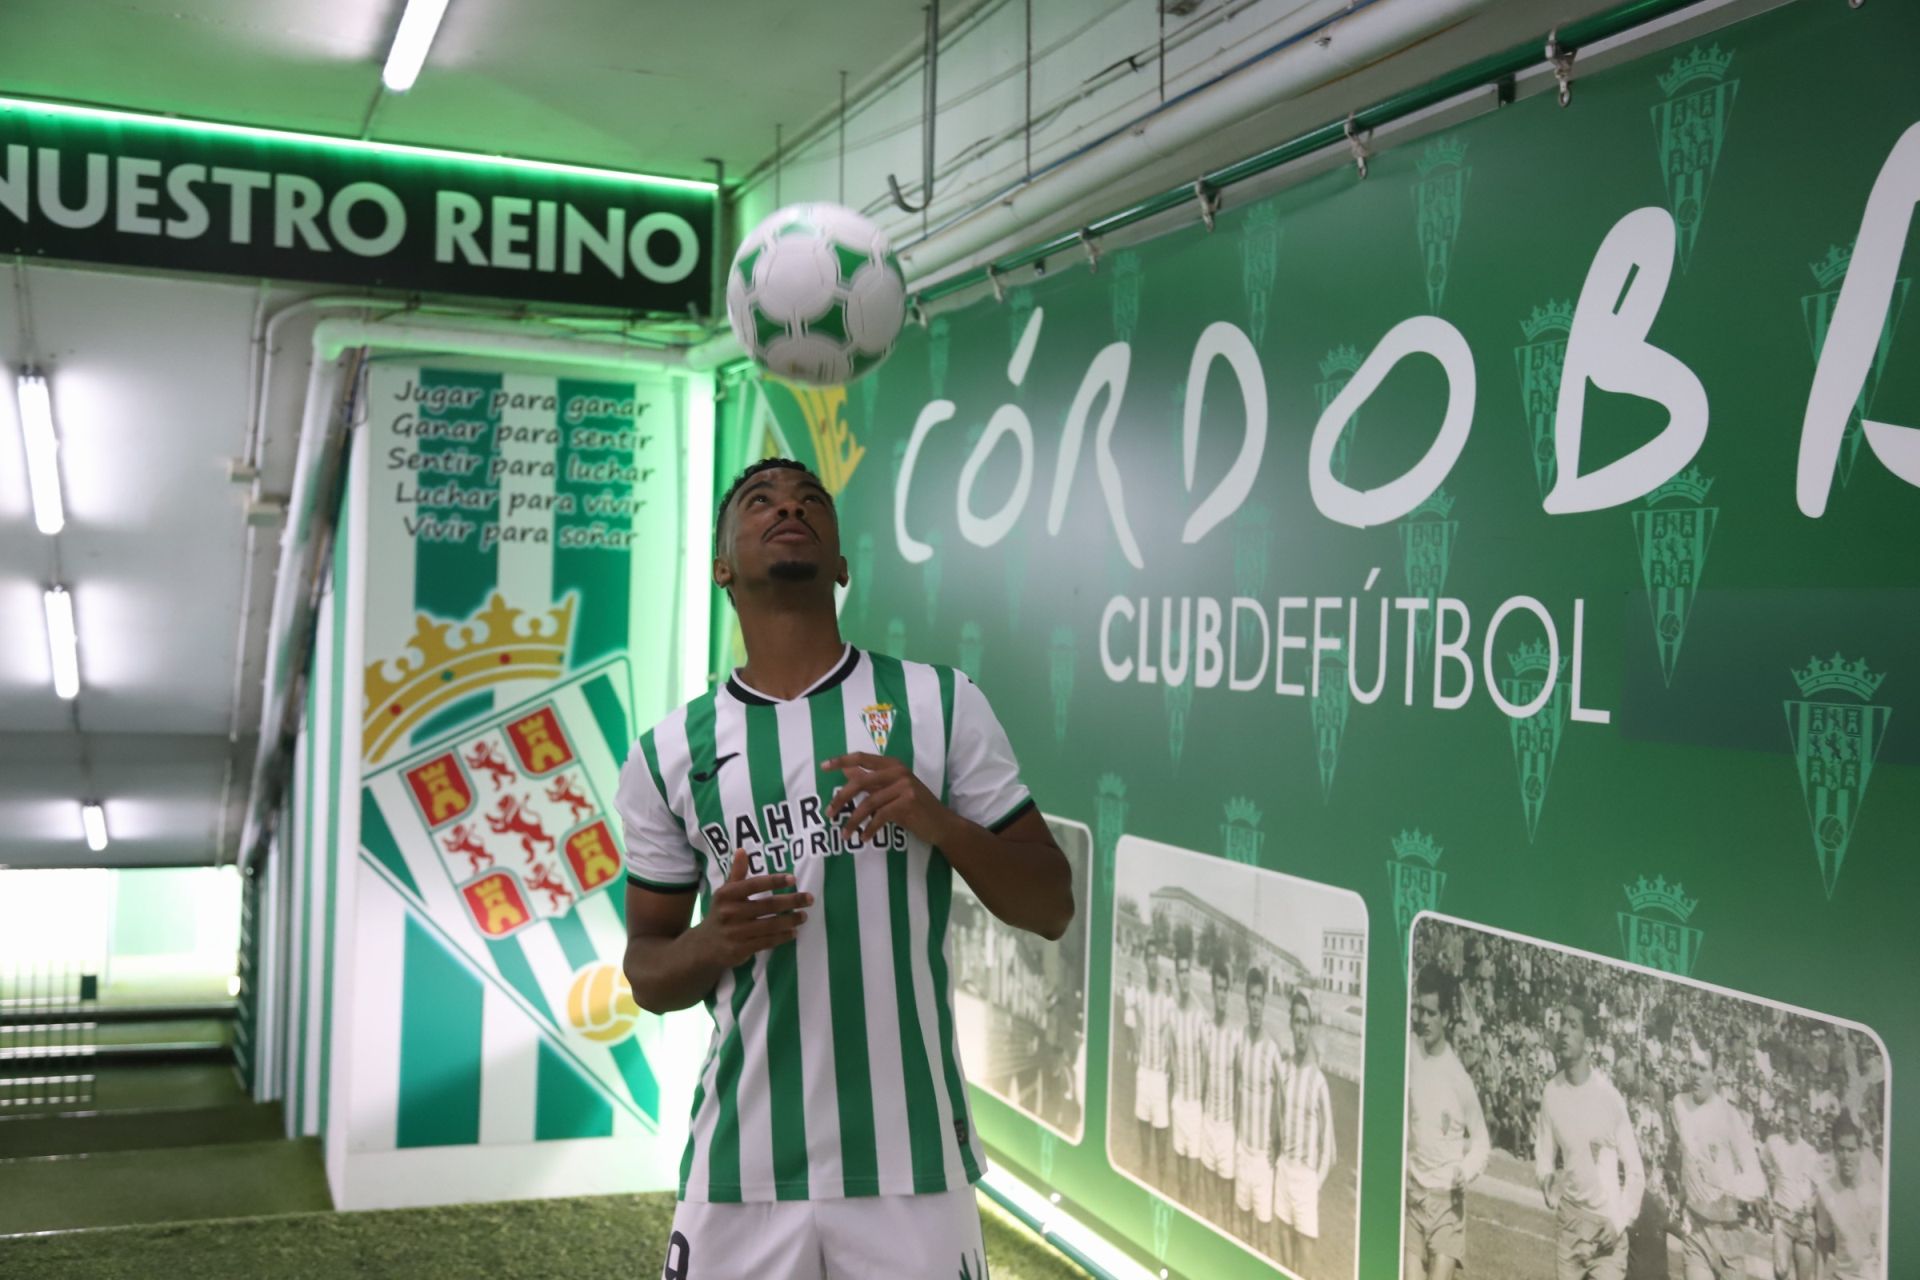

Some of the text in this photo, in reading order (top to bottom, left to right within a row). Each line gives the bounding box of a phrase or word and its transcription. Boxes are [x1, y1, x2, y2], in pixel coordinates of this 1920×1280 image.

[435, 189, 700, 284] REINO
[394, 380, 652, 423] Jugar para ganar
[391, 412, 653, 451] Ganar para sentir
[387, 446, 656, 485] Sentir para luchar
[395, 481, 647, 517] Luchar para vivir
[403, 515, 638, 551] Vivir para soñar
[704, 785, 870, 856] BAHRA
[722, 823, 906, 875] CTORIOUS
